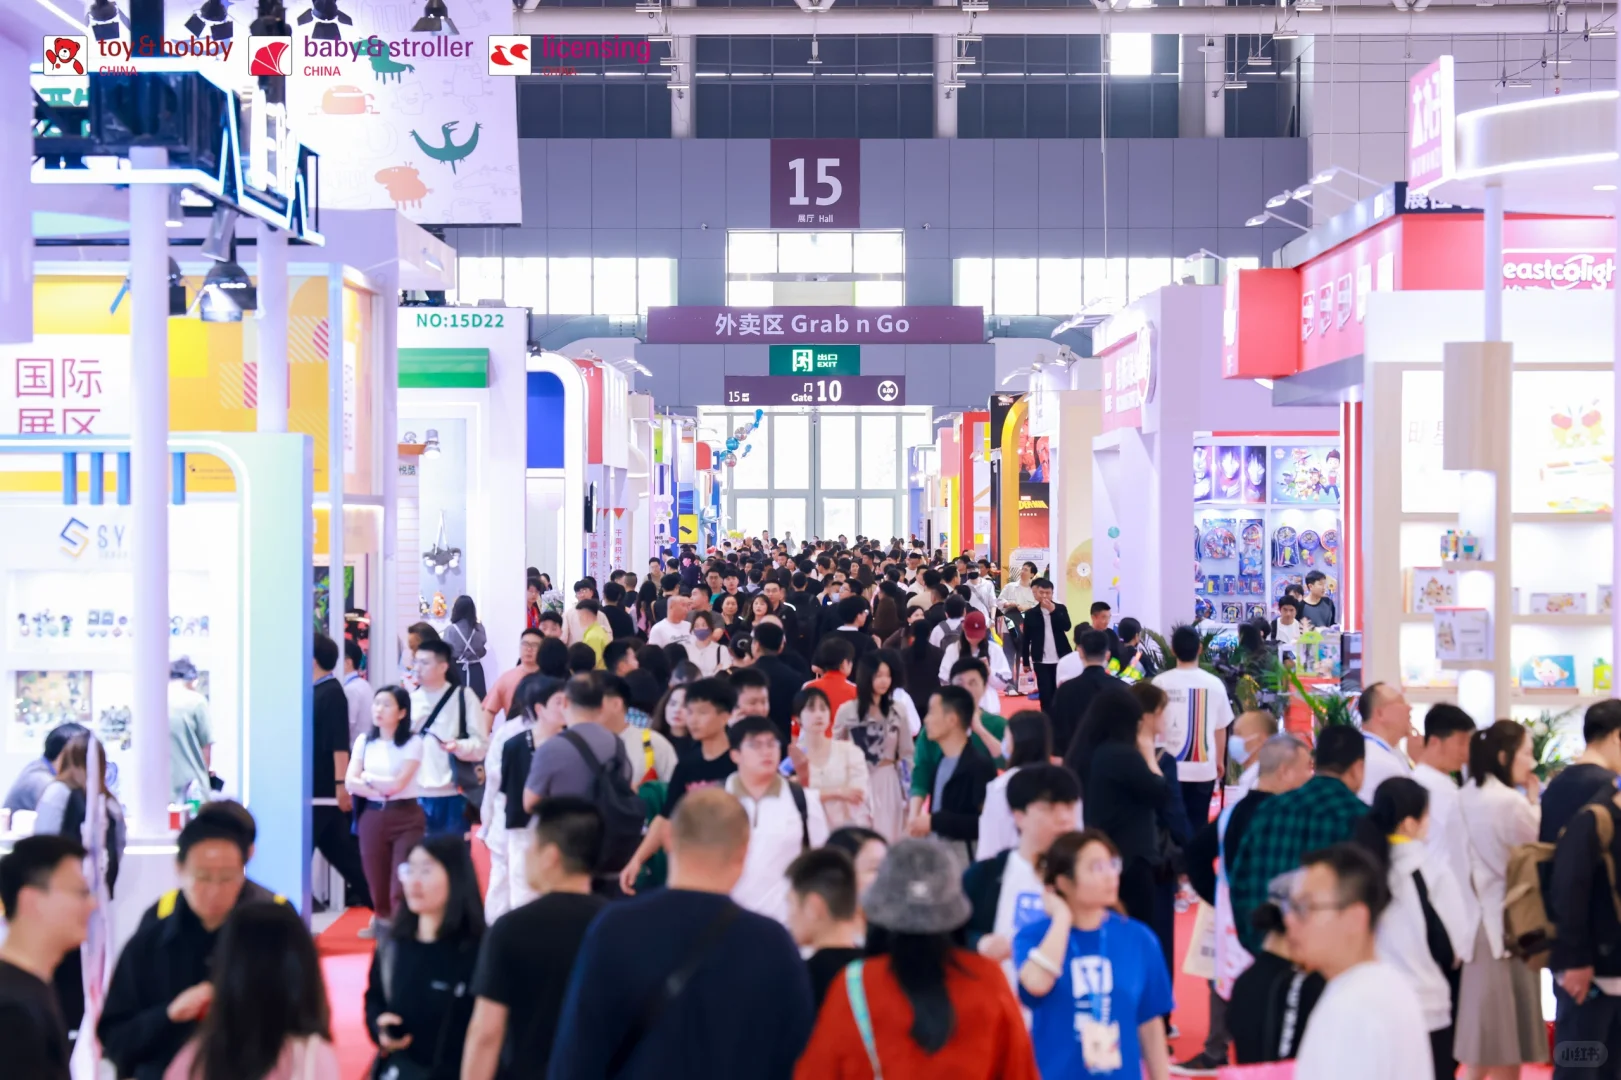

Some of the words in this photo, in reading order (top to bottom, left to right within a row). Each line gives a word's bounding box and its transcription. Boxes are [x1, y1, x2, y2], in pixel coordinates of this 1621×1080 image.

[788, 158, 843, 206] 15
[797, 214, 815, 223] 展厅
[818, 214, 834, 223] Hall
[416, 313, 504, 328] NO:15D22
[715, 313, 785, 336] 外卖区
[791, 313, 849, 333] Grab
[857, 319, 870, 333] n
[877, 314, 910, 333] Go
[817, 353, 838, 361] 出口
[15, 358, 103, 398] 国际
[728, 391, 740, 402] 15
[791, 393, 813, 402] Gate
[817, 380, 842, 402] 10
